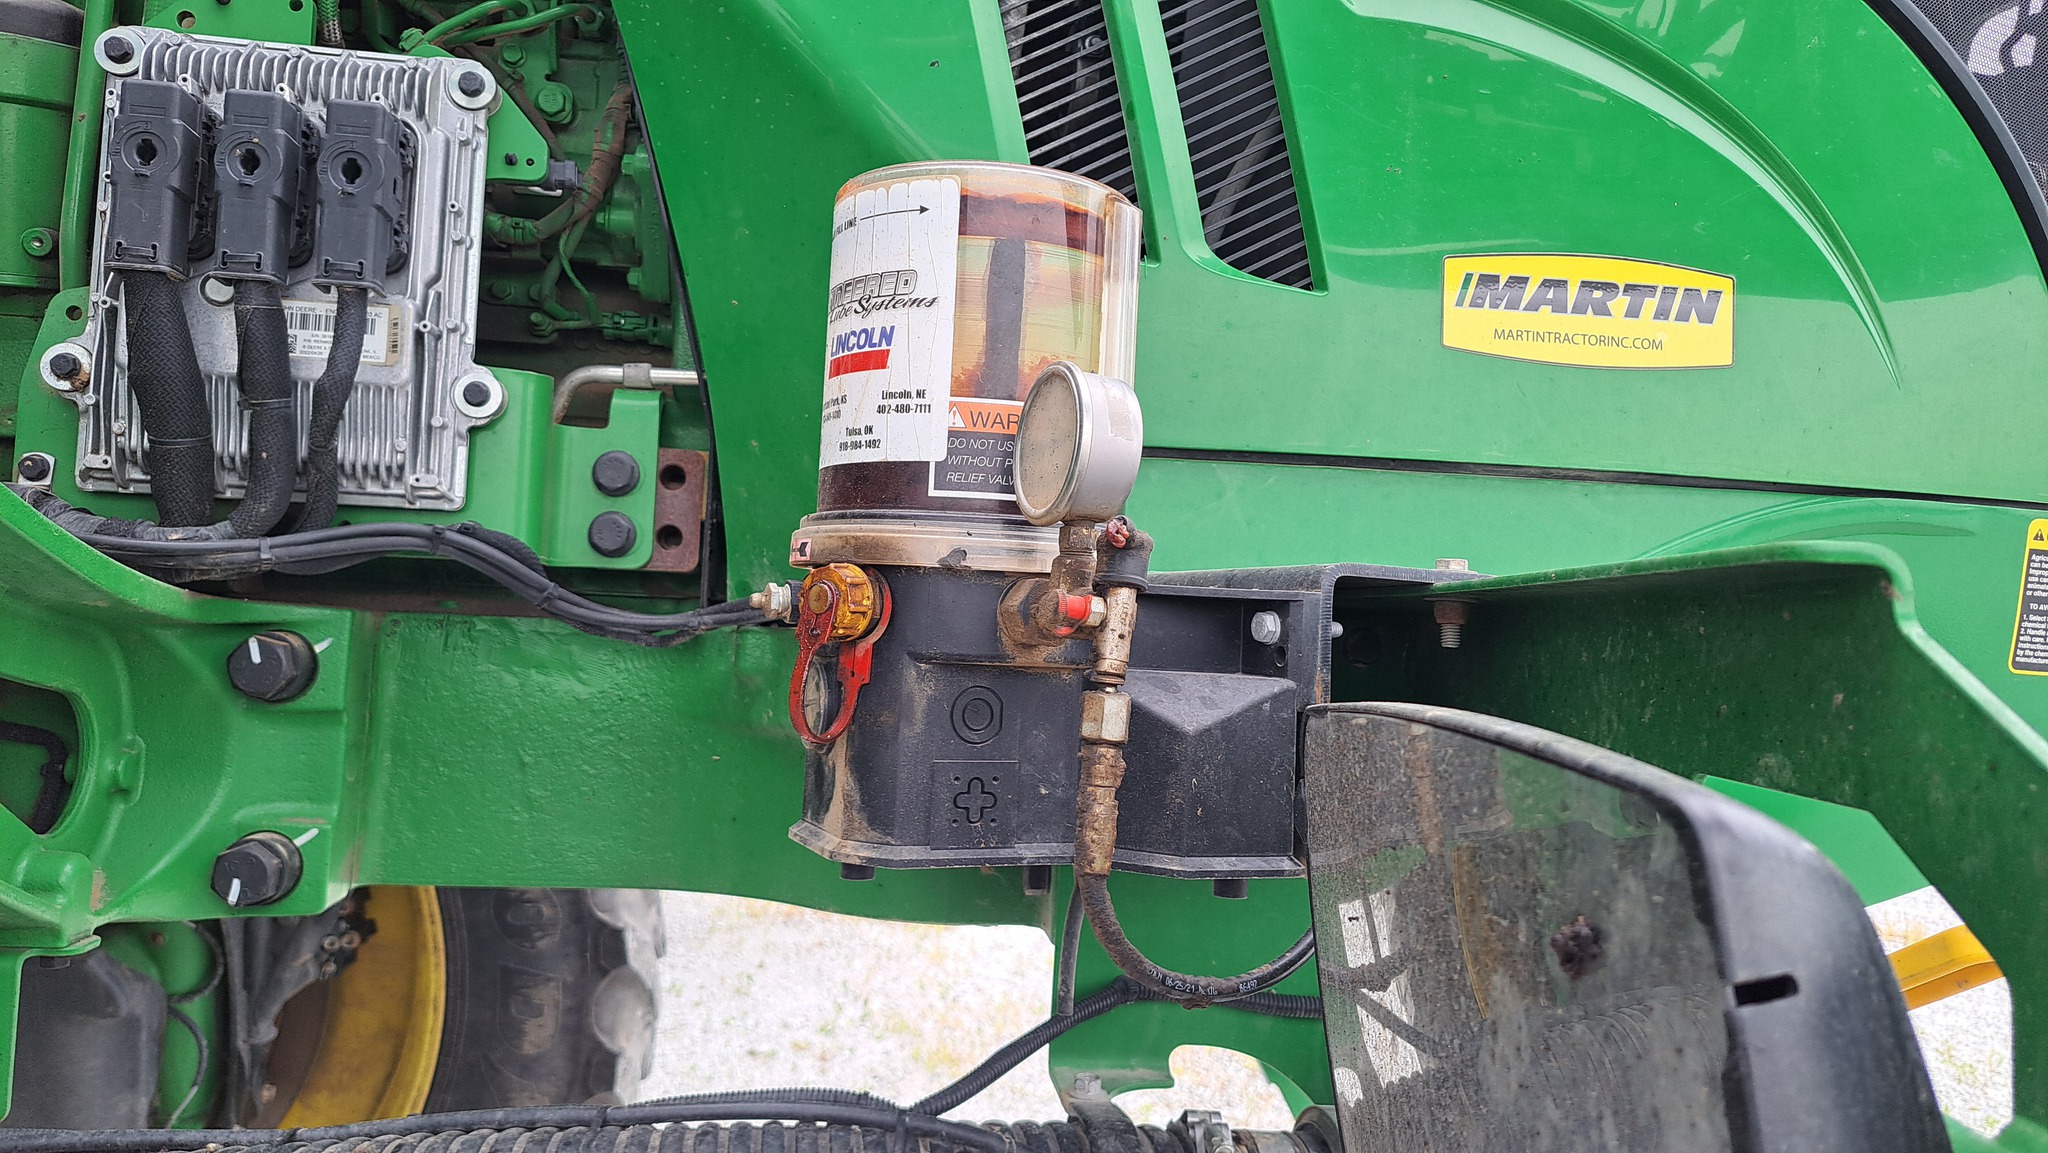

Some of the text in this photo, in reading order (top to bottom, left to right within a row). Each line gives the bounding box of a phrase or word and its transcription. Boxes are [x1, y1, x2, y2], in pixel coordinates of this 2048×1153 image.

[844, 217, 857, 230] LINE
[1468, 273, 1722, 324] MARTIN
[854, 295, 939, 319] Systems
[831, 325, 895, 357] LINCOLN
[1493, 328, 1663, 350] MARTINTRACTORINC.COM
[881, 389, 926, 400] Lincoln, NE
[876, 403, 931, 415] 402-480-7111
[845, 425, 874, 437] Tulsa, OK
[839, 438, 881, 451] 918-984-1492
[948, 438, 966, 448] DO
[968, 438, 996, 450] NOT
[947, 455, 1003, 467] WITHOUT
[946, 471, 986, 483] RELIEF
[2028, 614, 2046, 622] Select
[2021, 621, 2046, 629] chemical
